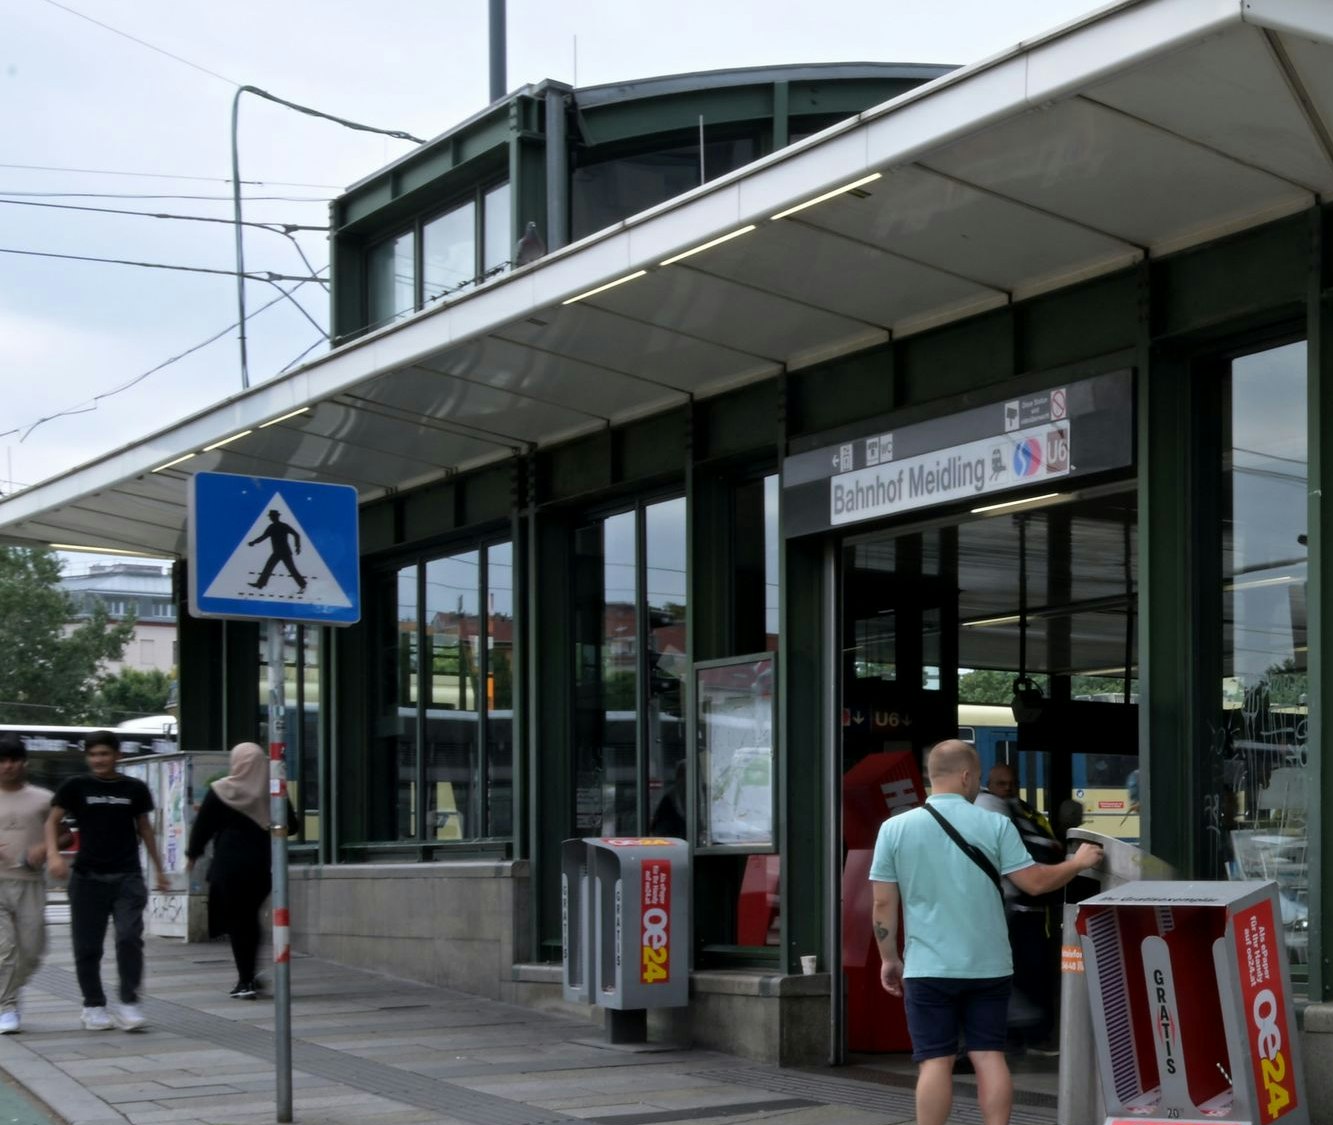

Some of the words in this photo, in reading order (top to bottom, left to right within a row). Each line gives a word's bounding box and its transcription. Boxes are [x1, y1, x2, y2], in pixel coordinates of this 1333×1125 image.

[1047, 438, 1067, 464] U6
[834, 471, 904, 515] Bahnhof
[909, 456, 985, 499] Meidling
[875, 711, 900, 727] U6
[643, 908, 668, 983] oe24
[1244, 928, 1252, 946] auf
[1258, 926, 1267, 943] Als
[1253, 950, 1264, 984] Handy
[1260, 943, 1271, 980] ePaper
[1153, 969, 1177, 1075] GRATIS
[1253, 988, 1290, 1120] oe24
